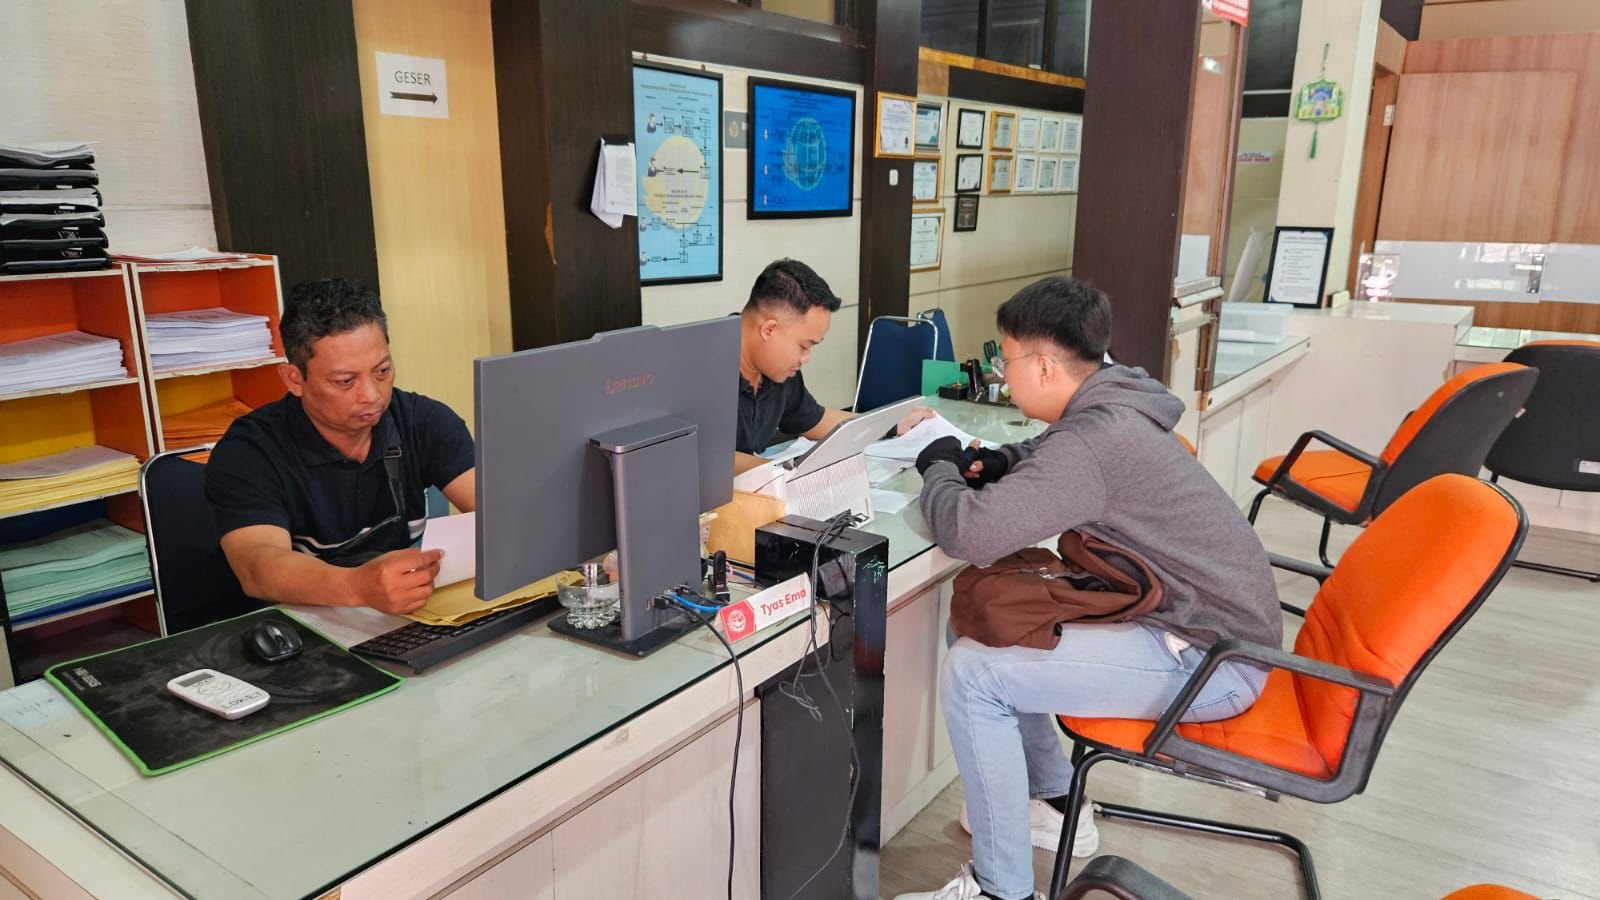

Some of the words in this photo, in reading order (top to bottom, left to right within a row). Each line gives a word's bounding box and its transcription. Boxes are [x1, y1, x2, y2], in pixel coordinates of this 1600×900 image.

[394, 70, 431, 85] GESER
[604, 372, 655, 395] Lenovo
[760, 599, 784, 616] Tyas
[785, 588, 806, 605] Ema
